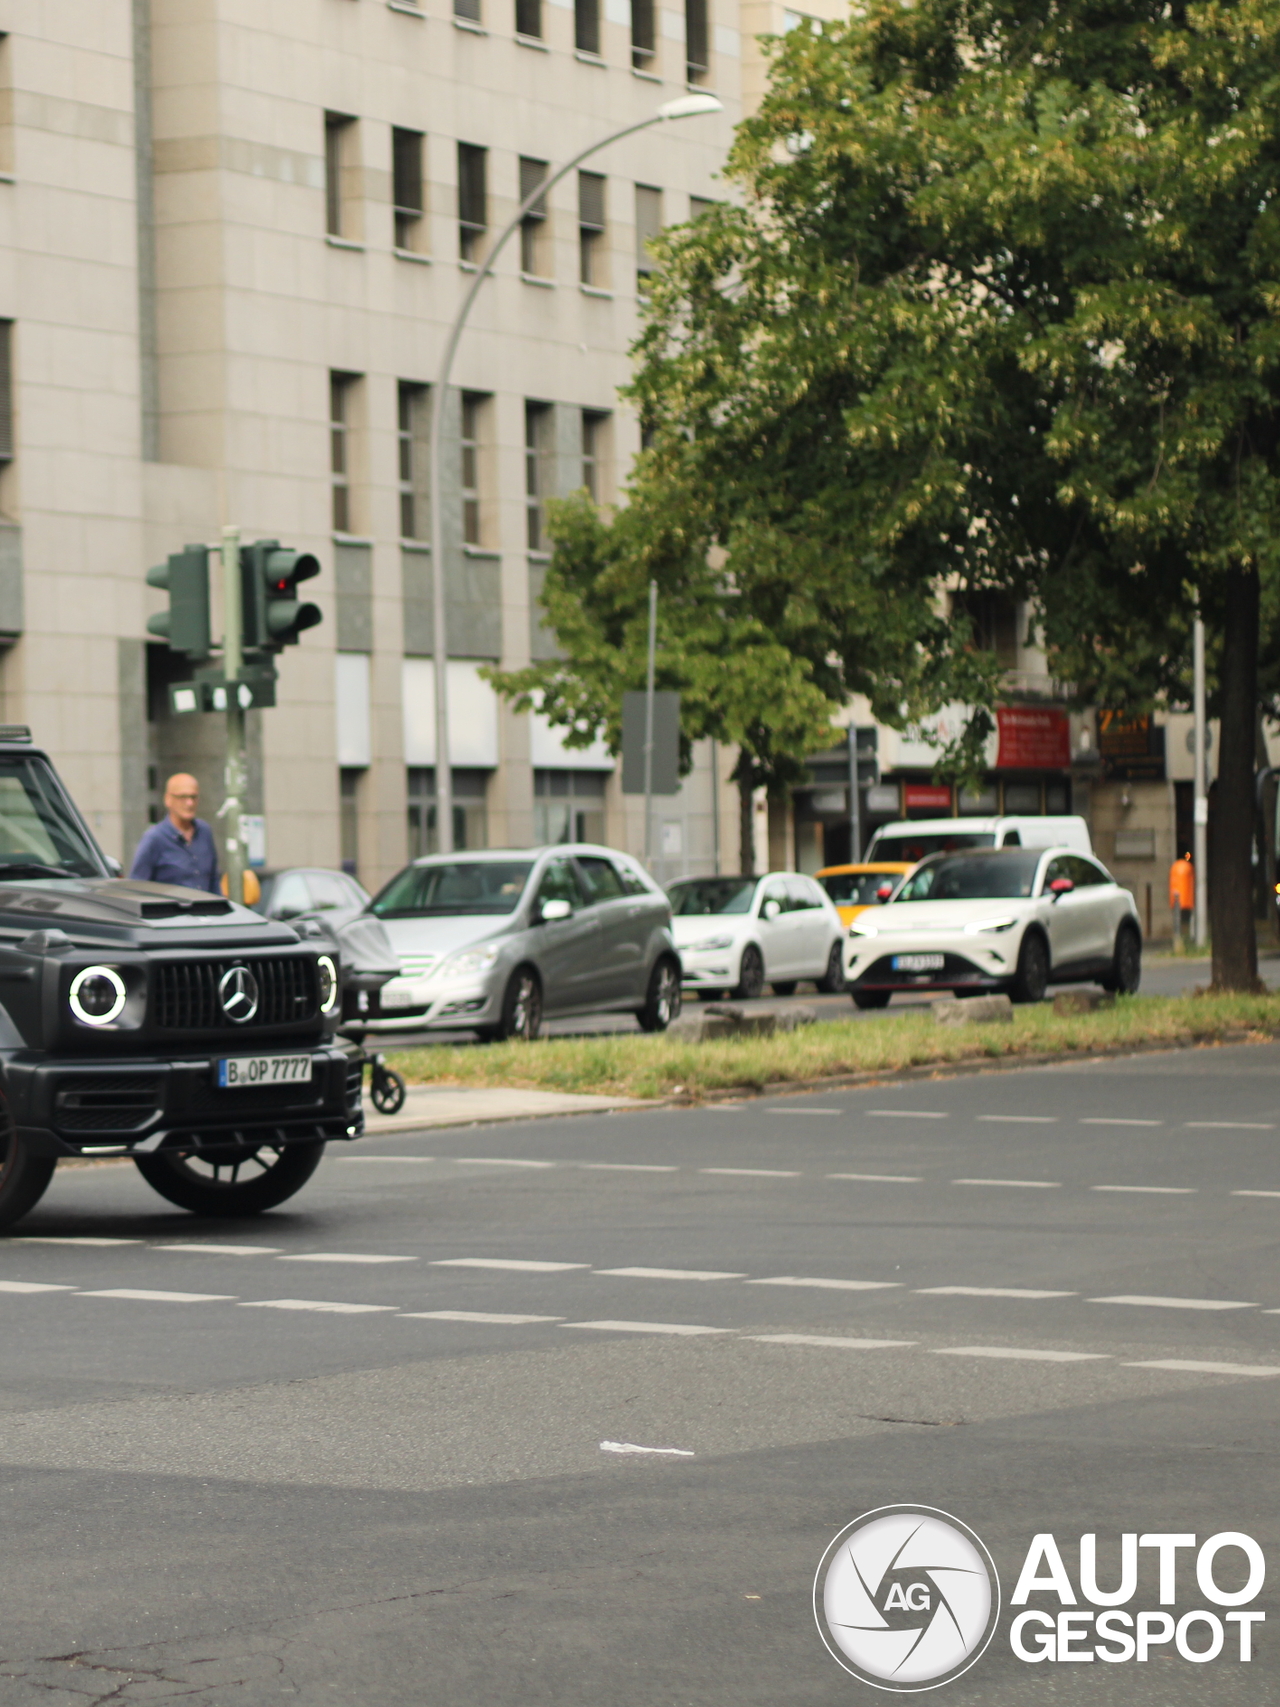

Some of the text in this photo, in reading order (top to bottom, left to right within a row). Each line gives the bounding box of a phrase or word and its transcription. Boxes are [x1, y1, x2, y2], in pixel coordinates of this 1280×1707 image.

[228, 1057, 310, 1083] B OP 7777
